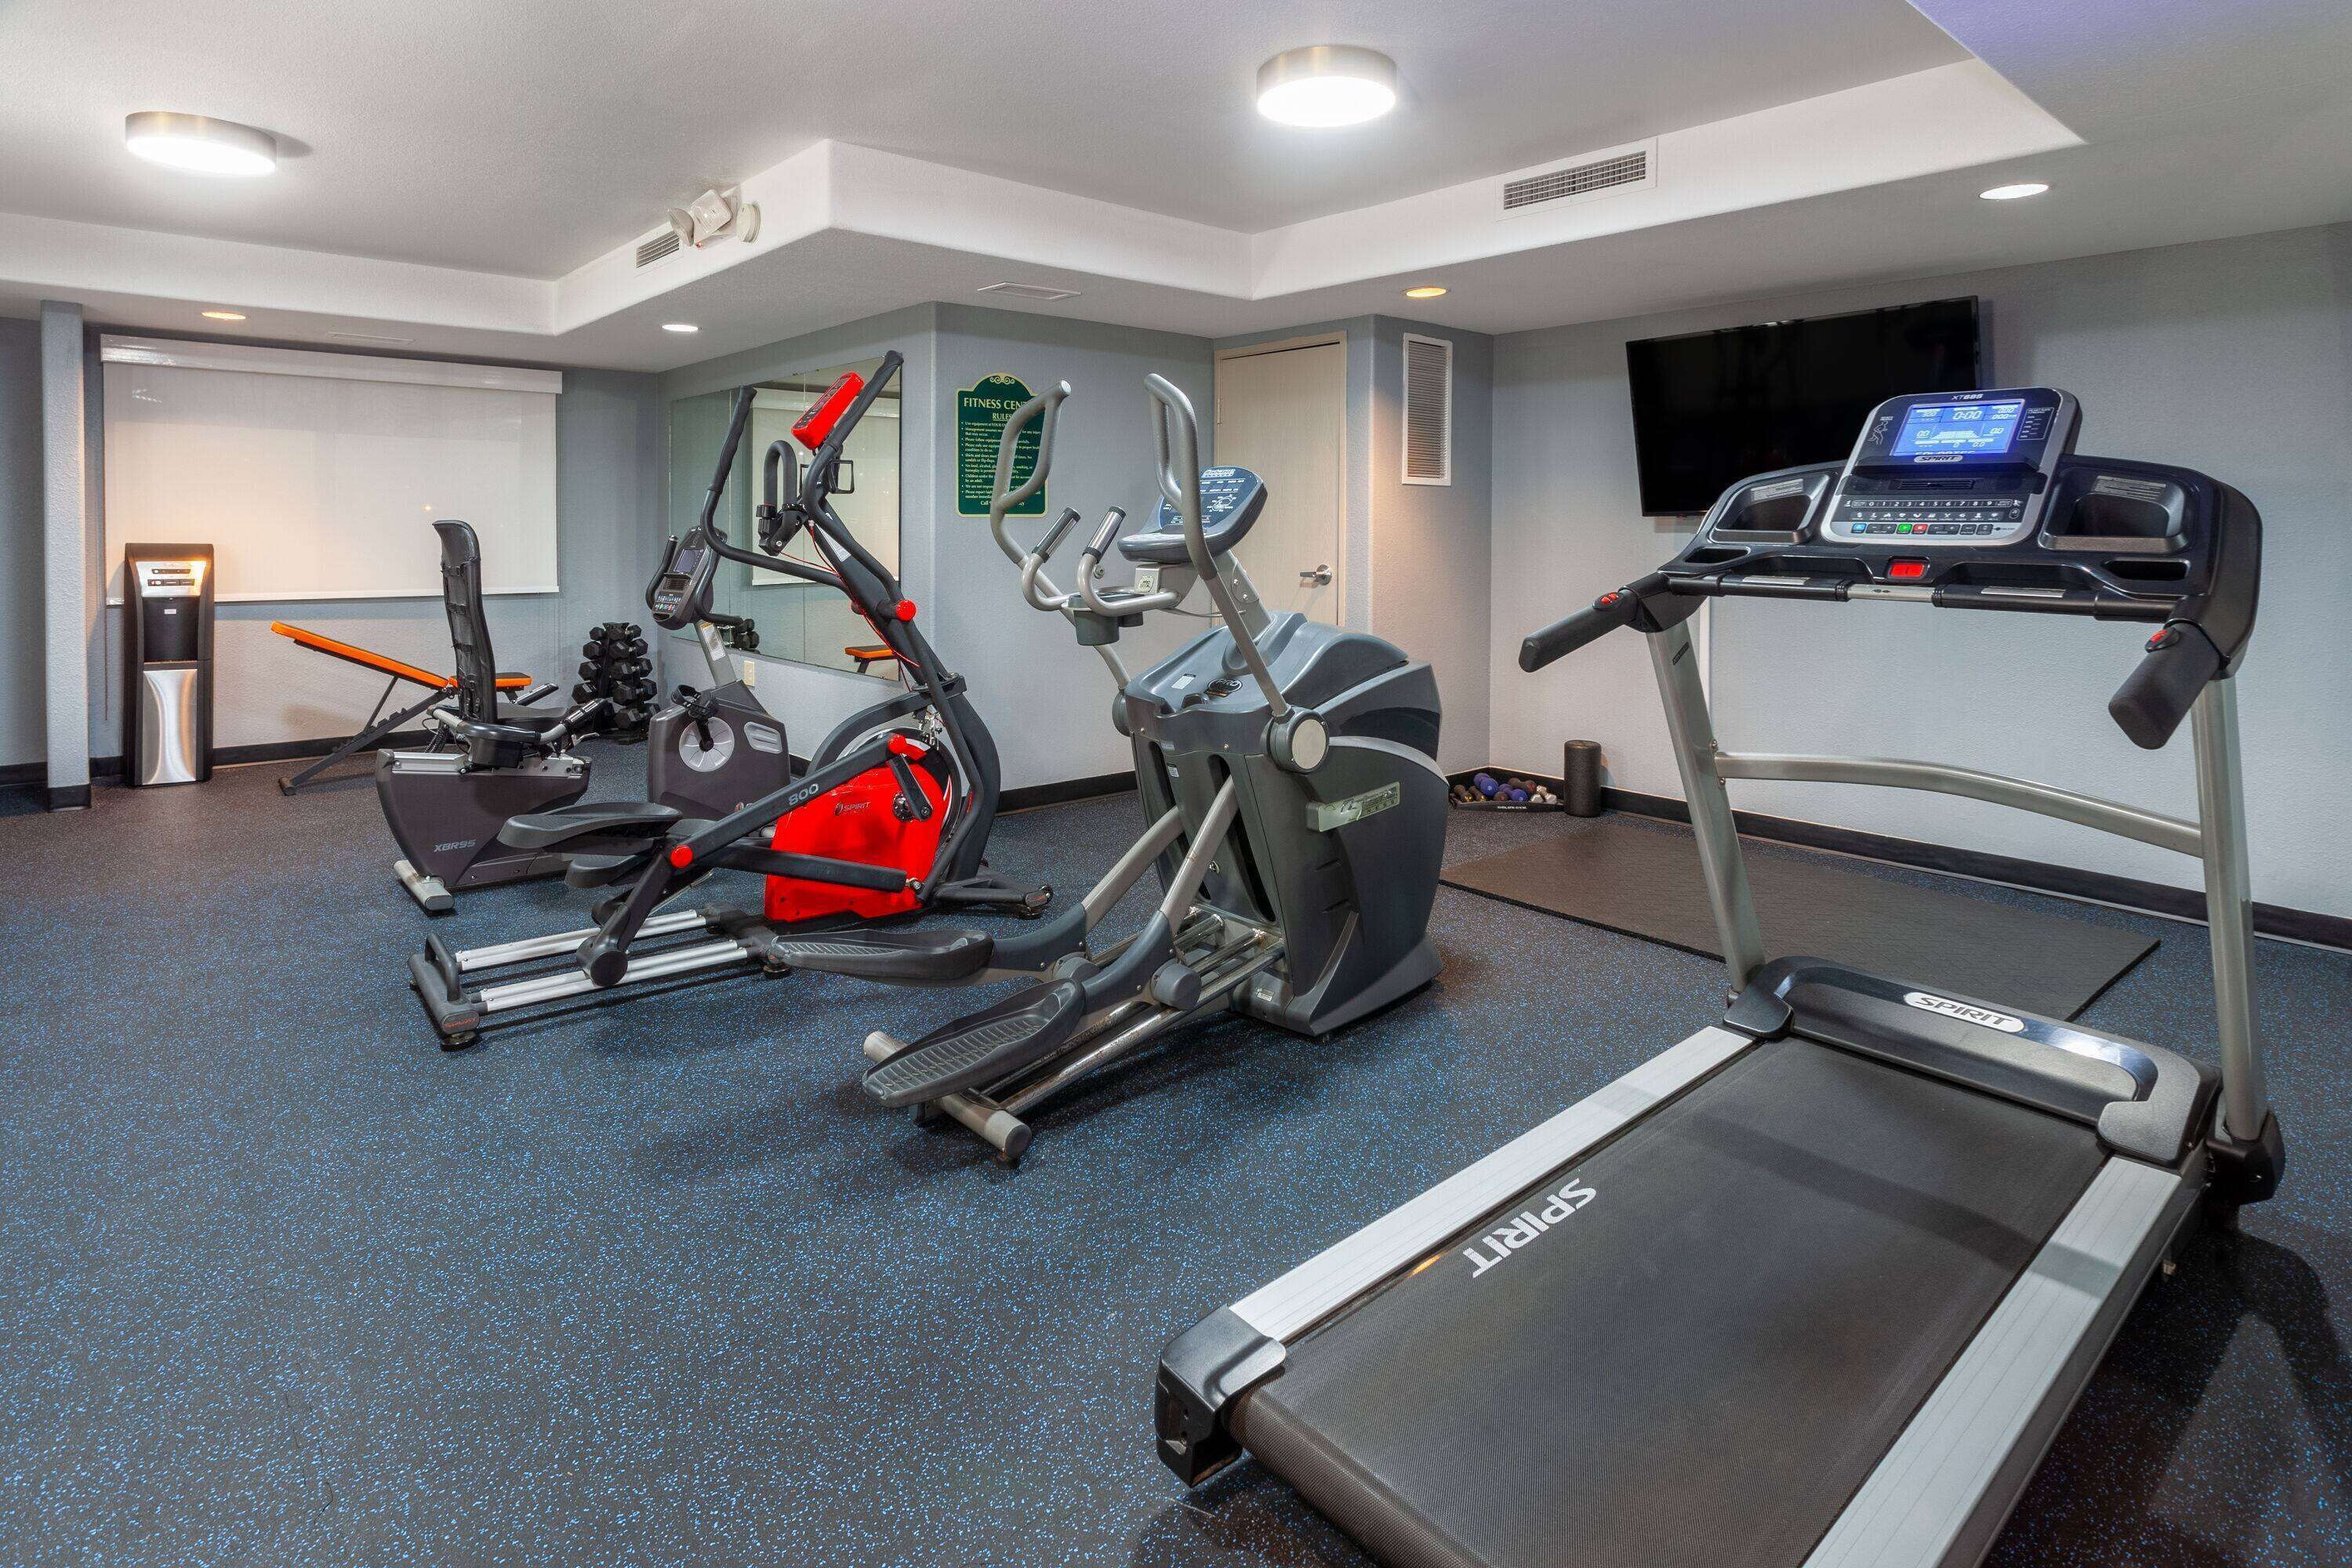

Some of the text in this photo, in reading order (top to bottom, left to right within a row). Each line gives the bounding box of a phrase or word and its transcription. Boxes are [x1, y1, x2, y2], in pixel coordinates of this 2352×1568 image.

[964, 397, 1030, 410] FITNESS CEN
[789, 784, 819, 806] 800
[842, 802, 871, 811] SPIRIT
[1916, 997, 2012, 1025] SPIRIT
[1462, 1178, 1597, 1279] SPIRIT
